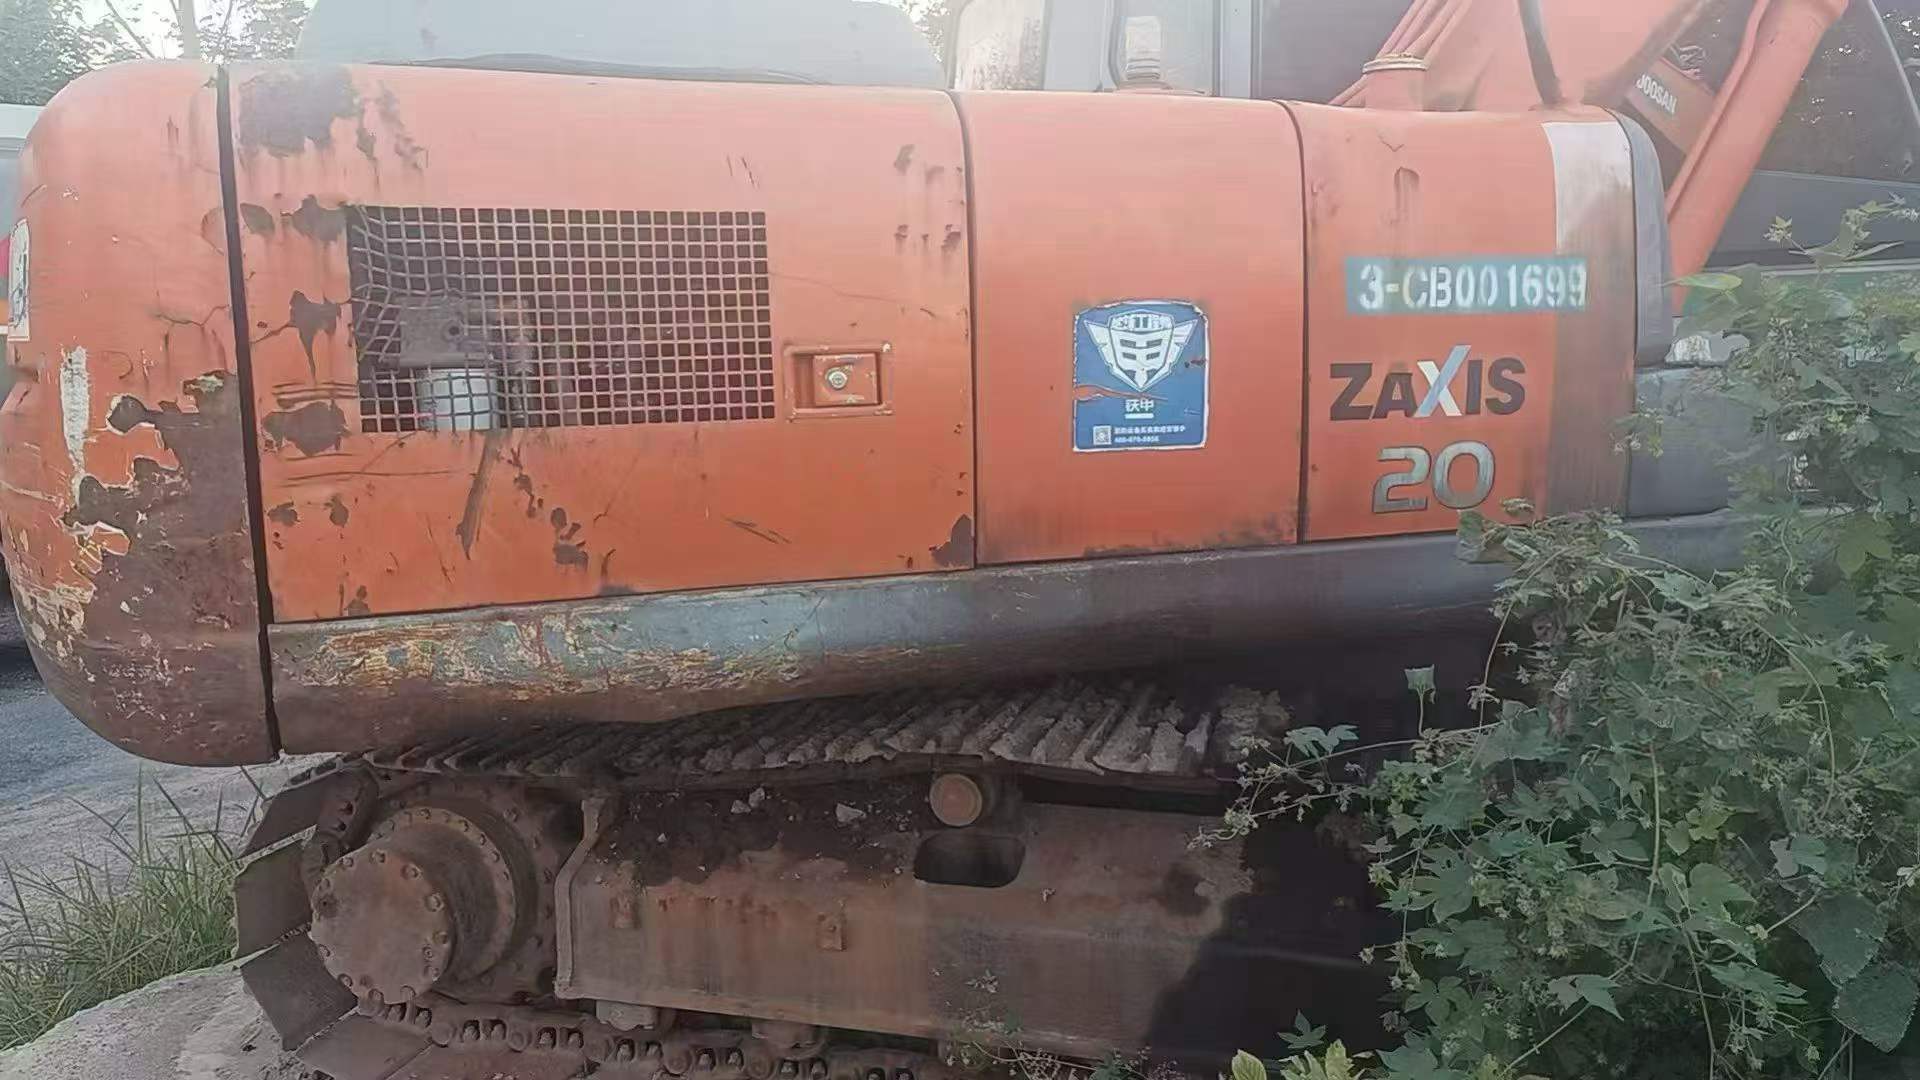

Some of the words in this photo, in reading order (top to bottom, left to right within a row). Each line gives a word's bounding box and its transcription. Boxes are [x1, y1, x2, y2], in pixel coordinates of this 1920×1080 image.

[1359, 262, 1587, 309] 3-CB001699
[1330, 344, 1526, 420] ZAXIS
[1372, 441, 1496, 513] 20
